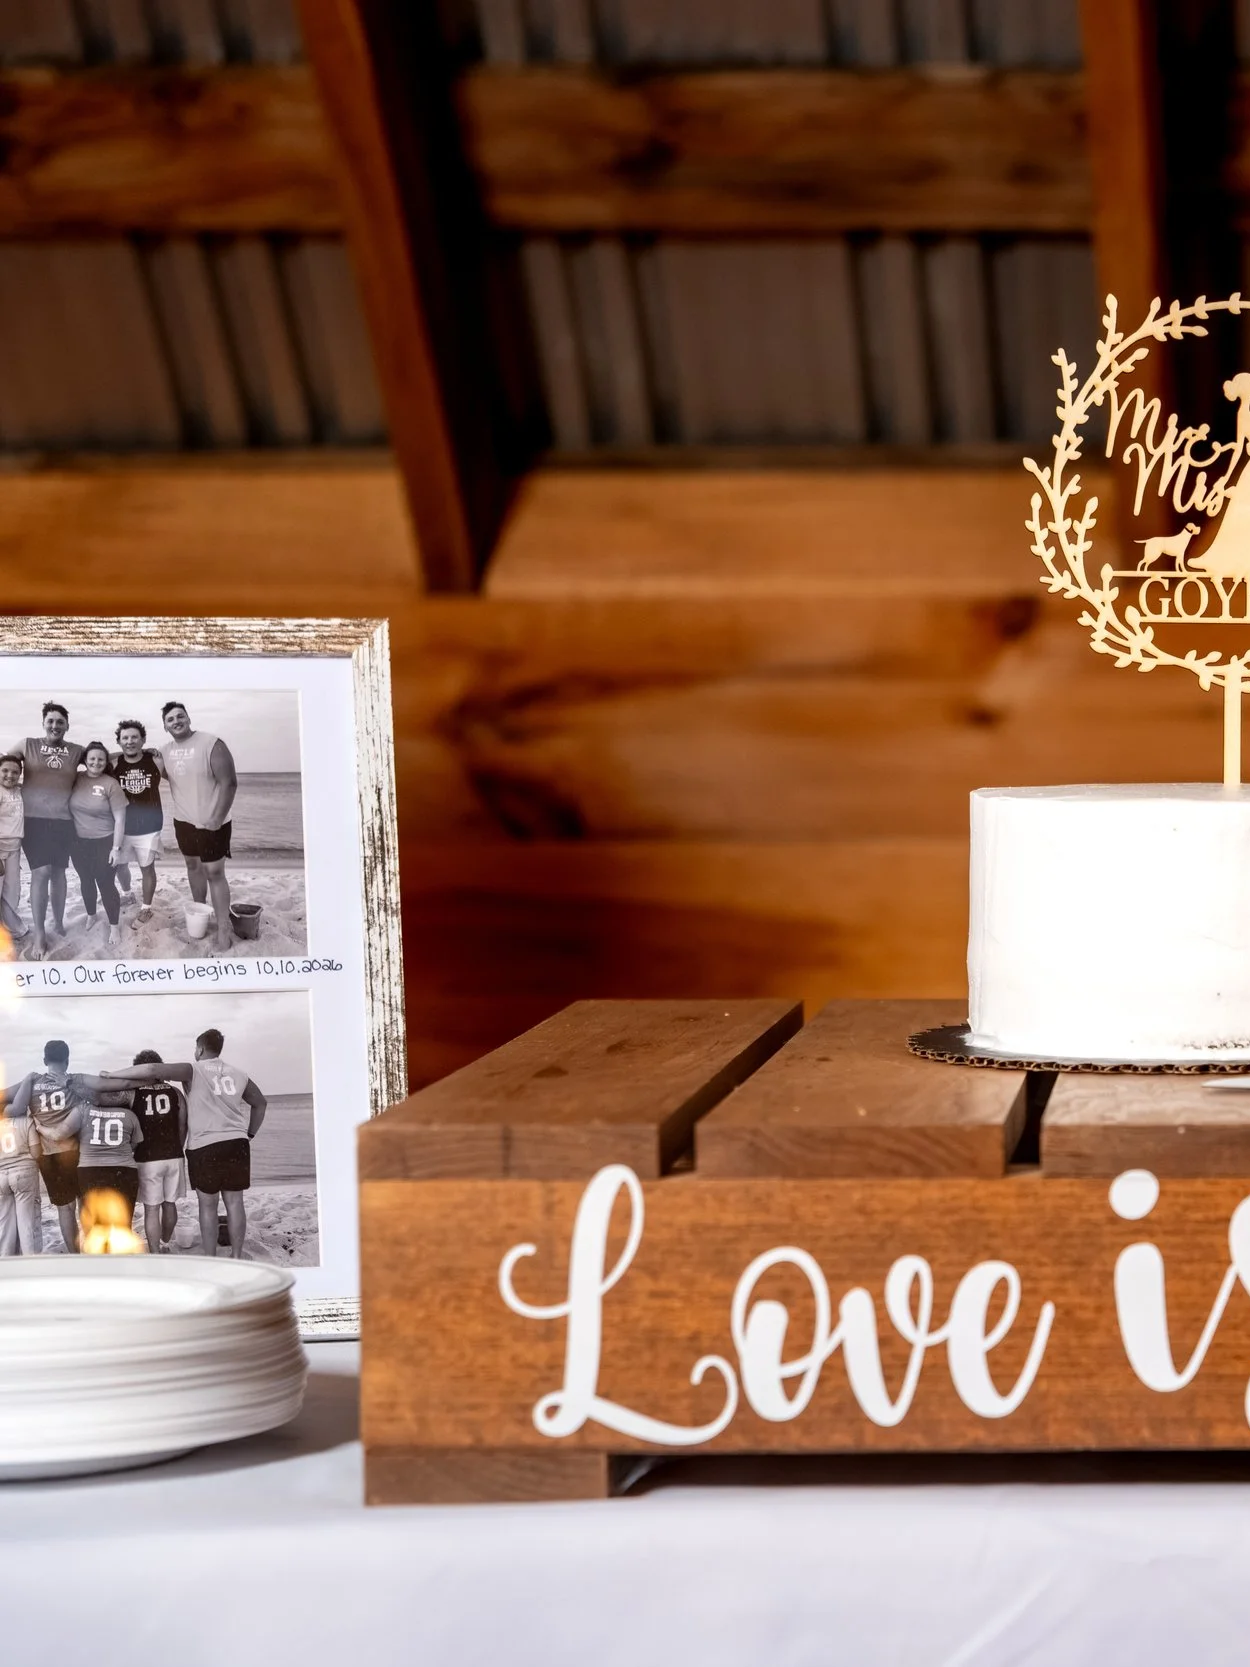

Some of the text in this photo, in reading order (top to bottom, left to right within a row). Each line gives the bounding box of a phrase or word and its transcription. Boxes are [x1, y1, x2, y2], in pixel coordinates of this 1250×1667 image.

[1103, 388, 1192, 458] Mr
[1122, 442, 1236, 517] Mrs
[120, 777, 151, 788] LEAGUE
[15, 972, 34, 988] er
[74, 965, 106, 984] Our
[112, 963, 174, 984] forever
[183, 960, 247, 981] begins
[256, 958, 343, 976] 10.10.2026
[212, 1075, 237, 1096] 10
[39, 1090, 66, 1112] 10
[145, 1094, 171, 1115] 10
[89, 1118, 124, 1146] 10
[499, 1164, 1055, 1446] Love
